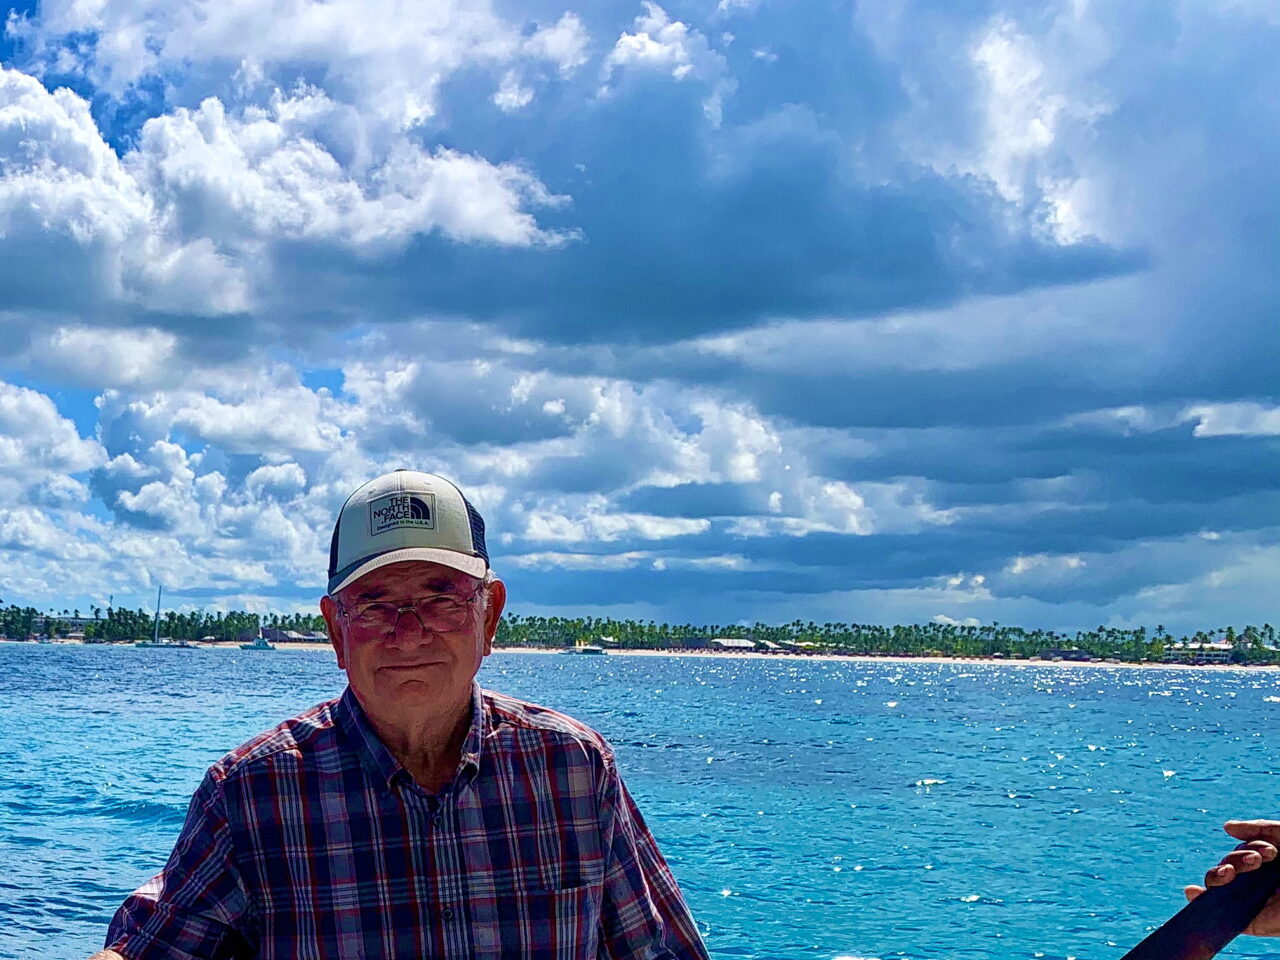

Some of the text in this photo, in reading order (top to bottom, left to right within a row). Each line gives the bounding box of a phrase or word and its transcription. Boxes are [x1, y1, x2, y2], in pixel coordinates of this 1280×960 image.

[389, 496, 409, 506] THE
[373, 504, 409, 519] NORTH
[384, 511, 410, 523] FACE
